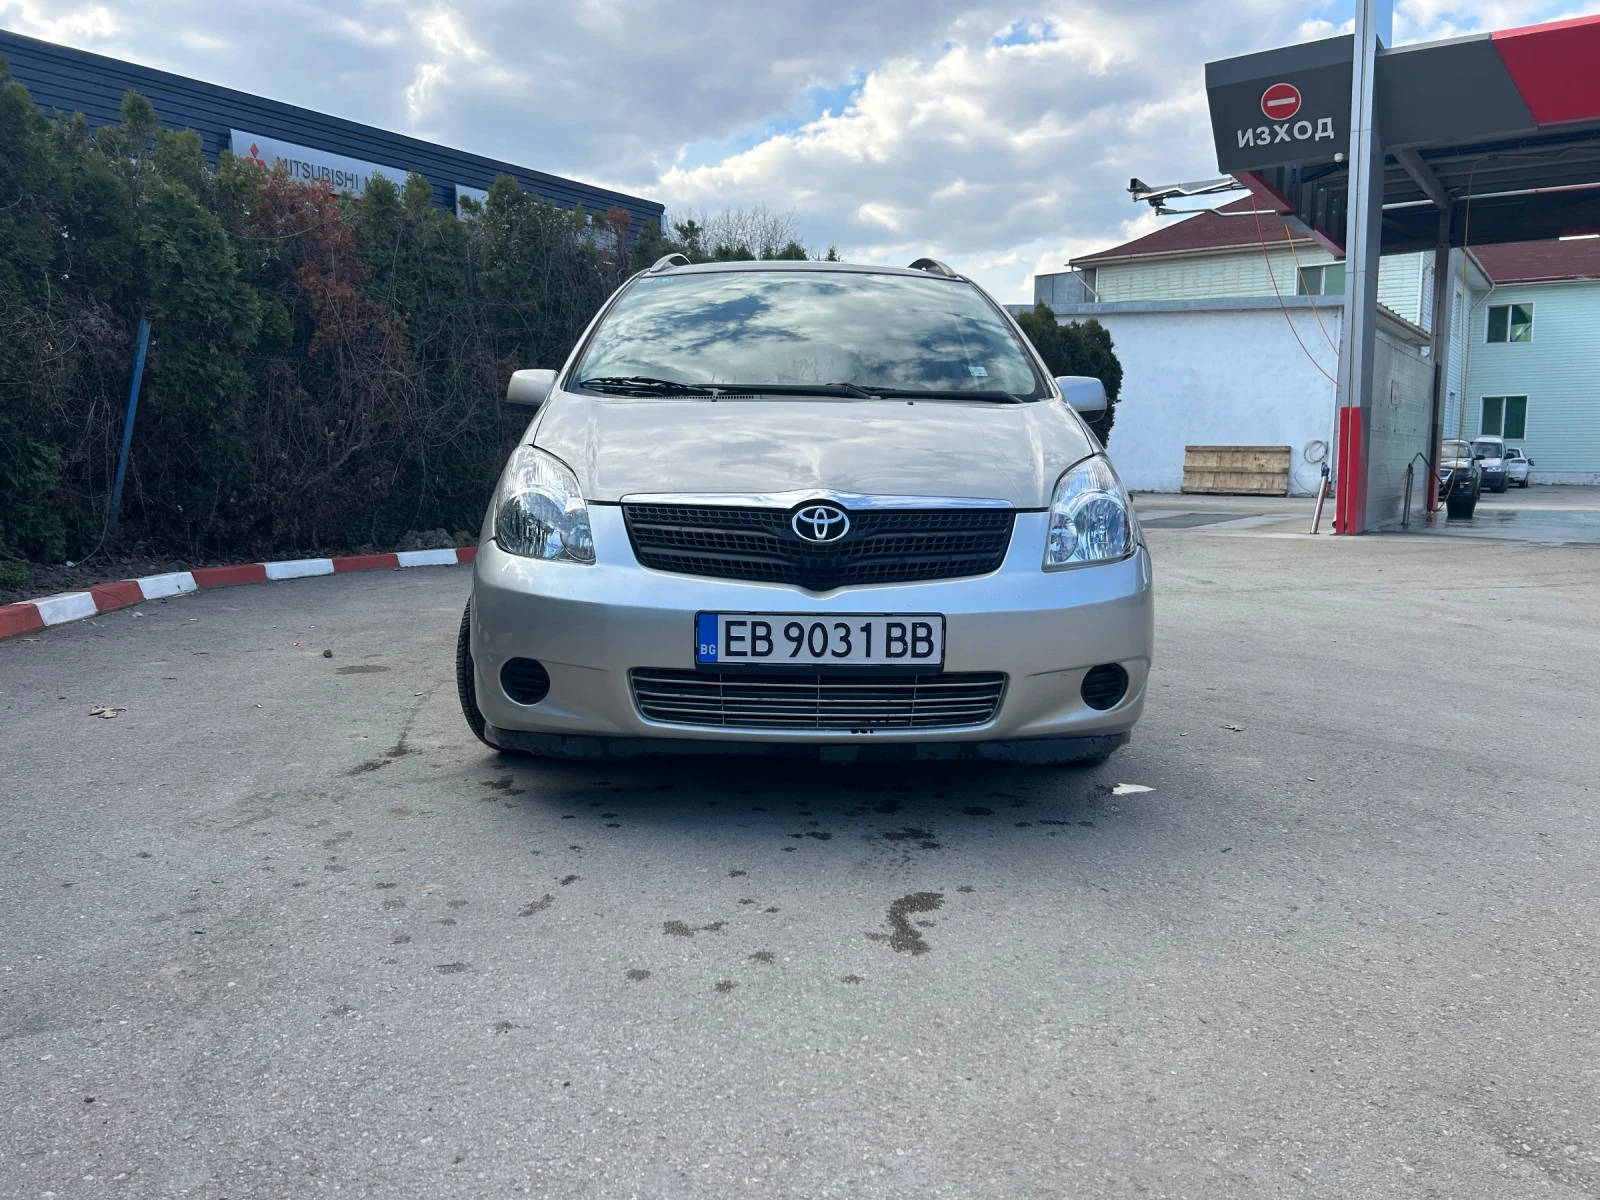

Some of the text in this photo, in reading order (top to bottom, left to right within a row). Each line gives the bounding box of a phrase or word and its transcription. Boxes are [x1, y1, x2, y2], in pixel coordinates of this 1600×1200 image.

[1237, 117, 1334, 148] ИЗХОД
[700, 643, 717, 655] BG
[724, 620, 935, 659] EB 9031 BB
